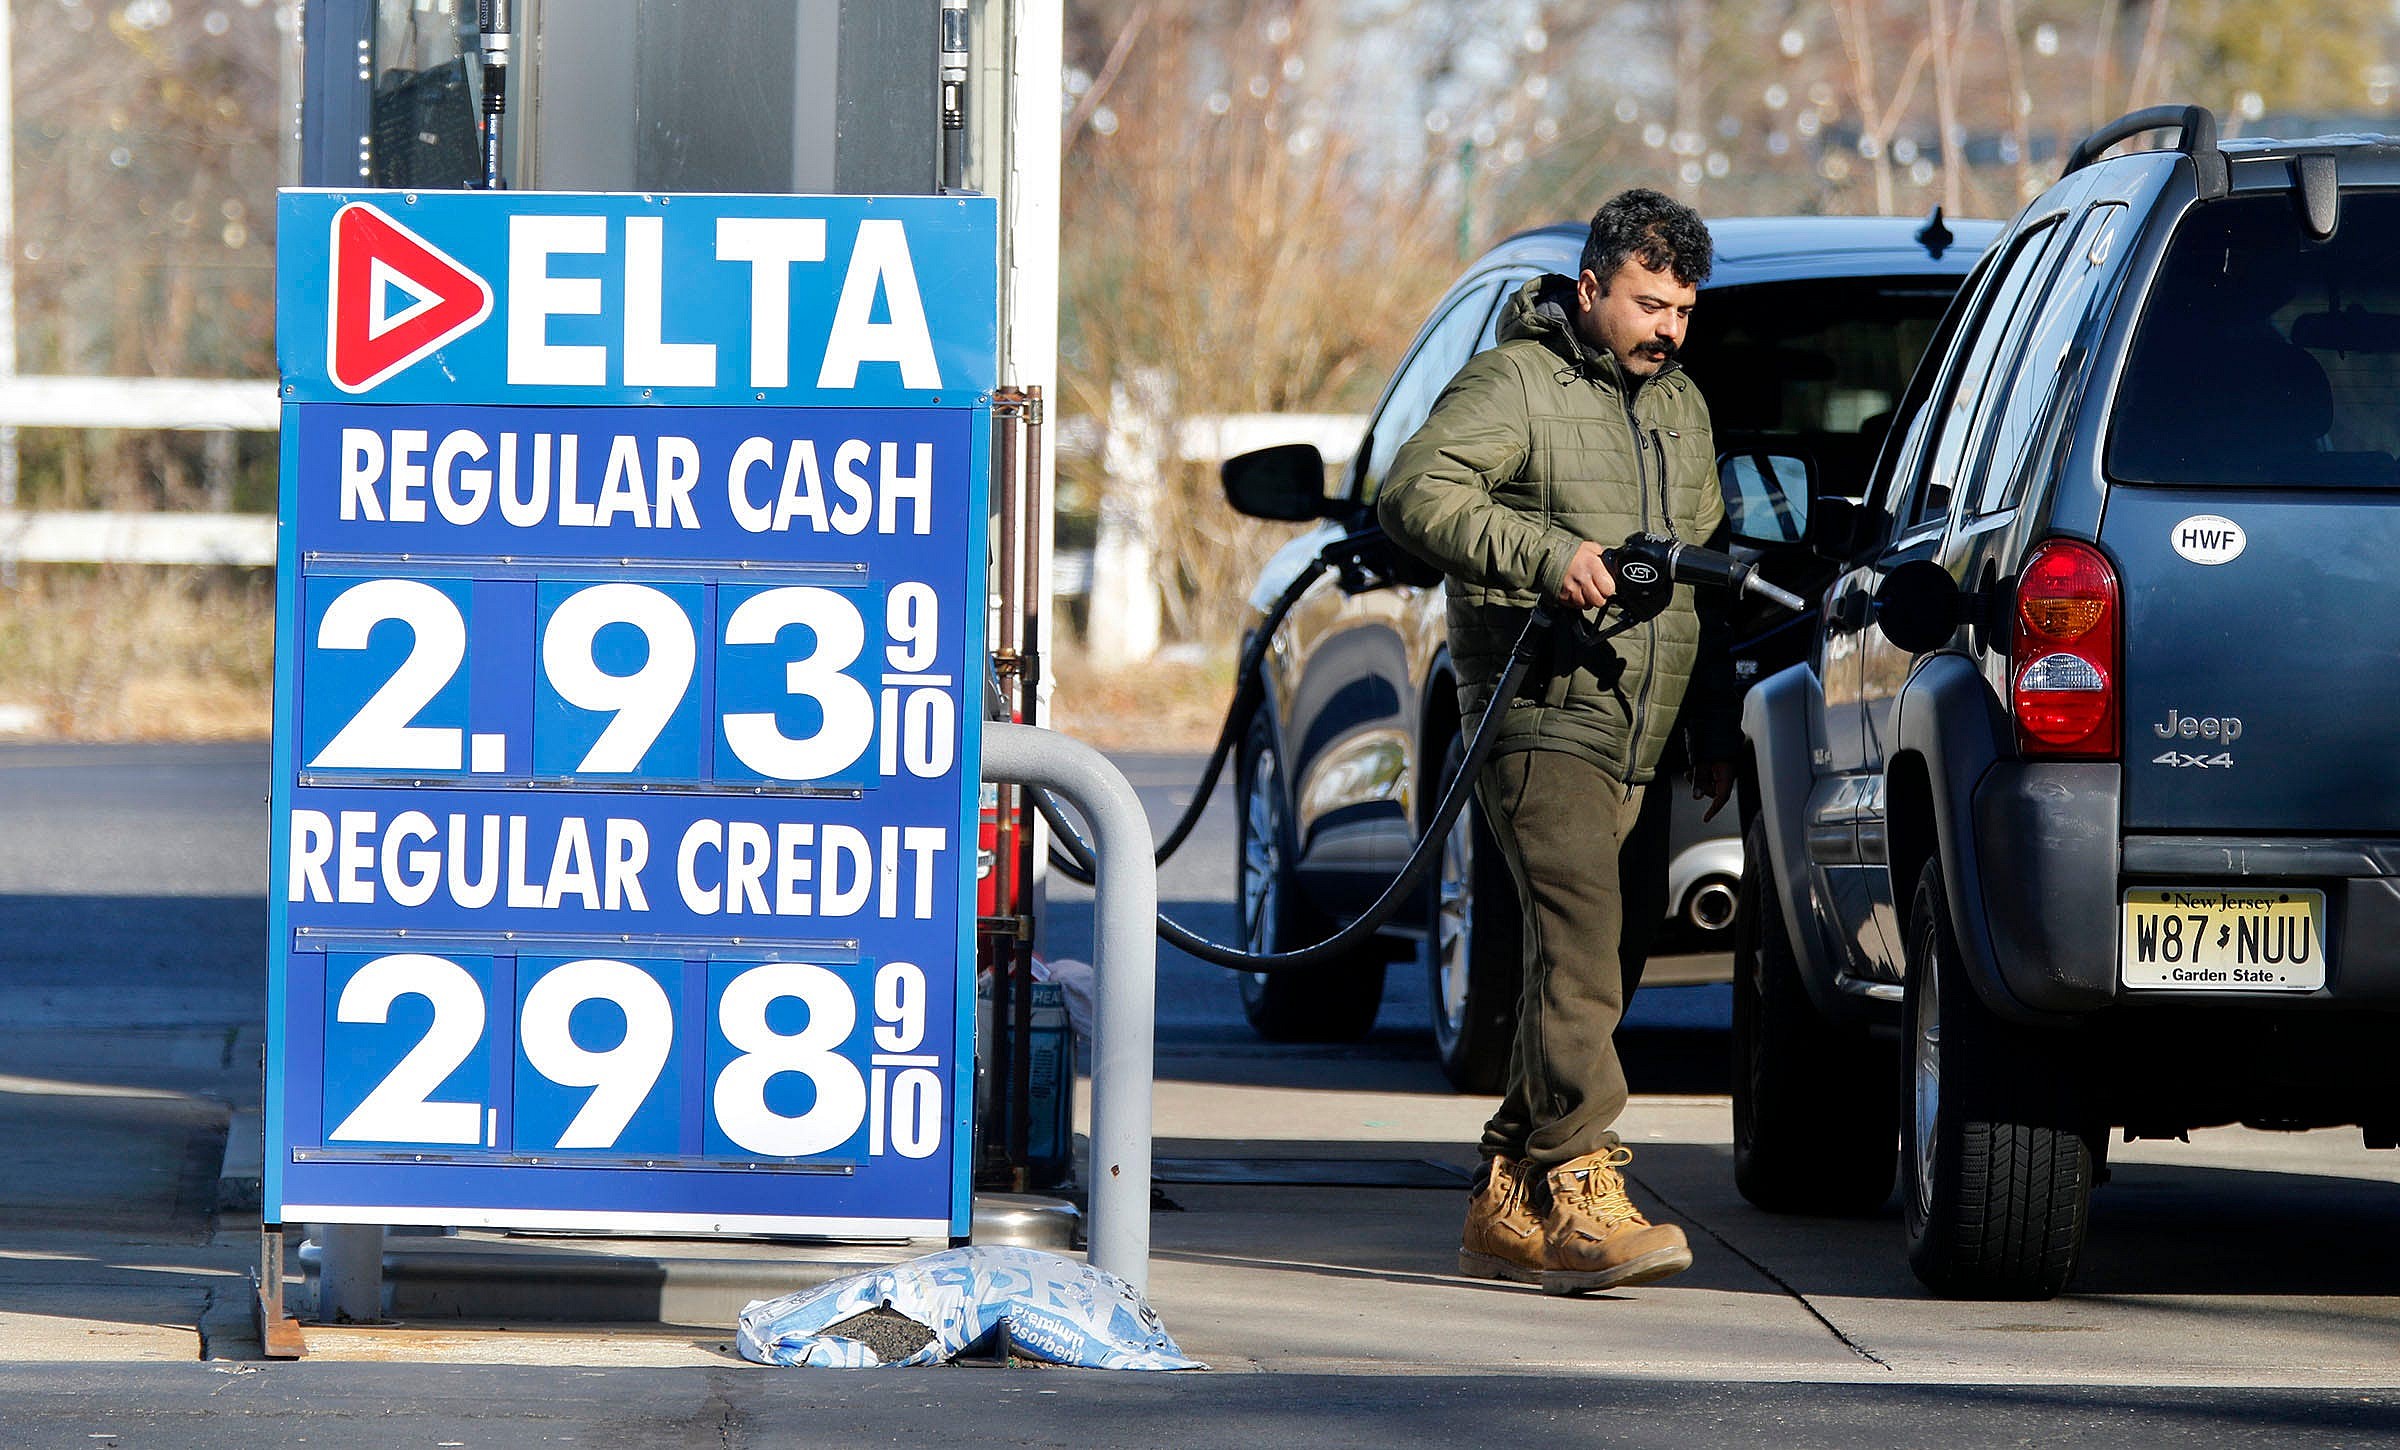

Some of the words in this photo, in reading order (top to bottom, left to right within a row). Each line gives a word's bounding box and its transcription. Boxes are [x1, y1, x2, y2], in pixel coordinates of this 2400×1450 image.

[339, 428, 700, 530] REGULAR
[727, 437, 932, 535] CASH
[2182, 528, 2236, 550] HWF
[1629, 566, 1651, 579] VST
[305, 579, 875, 781] 2.93
[2153, 709, 2243, 745] Jeep
[288, 809, 649, 911] REGULAR
[677, 819, 946, 920] CREDIT
[2174, 893, 2218, 909] New
[2218, 893, 2274, 913] Jersey
[2137, 914, 2208, 963] W87
[2237, 915, 2310, 964] NUU
[2172, 968, 2227, 982] Garden
[2233, 969, 2274, 982] State
[328, 953, 867, 1157] 298
[1005, 1317, 1084, 1365] bsorbent
[1011, 1304, 1085, 1349] Premium
